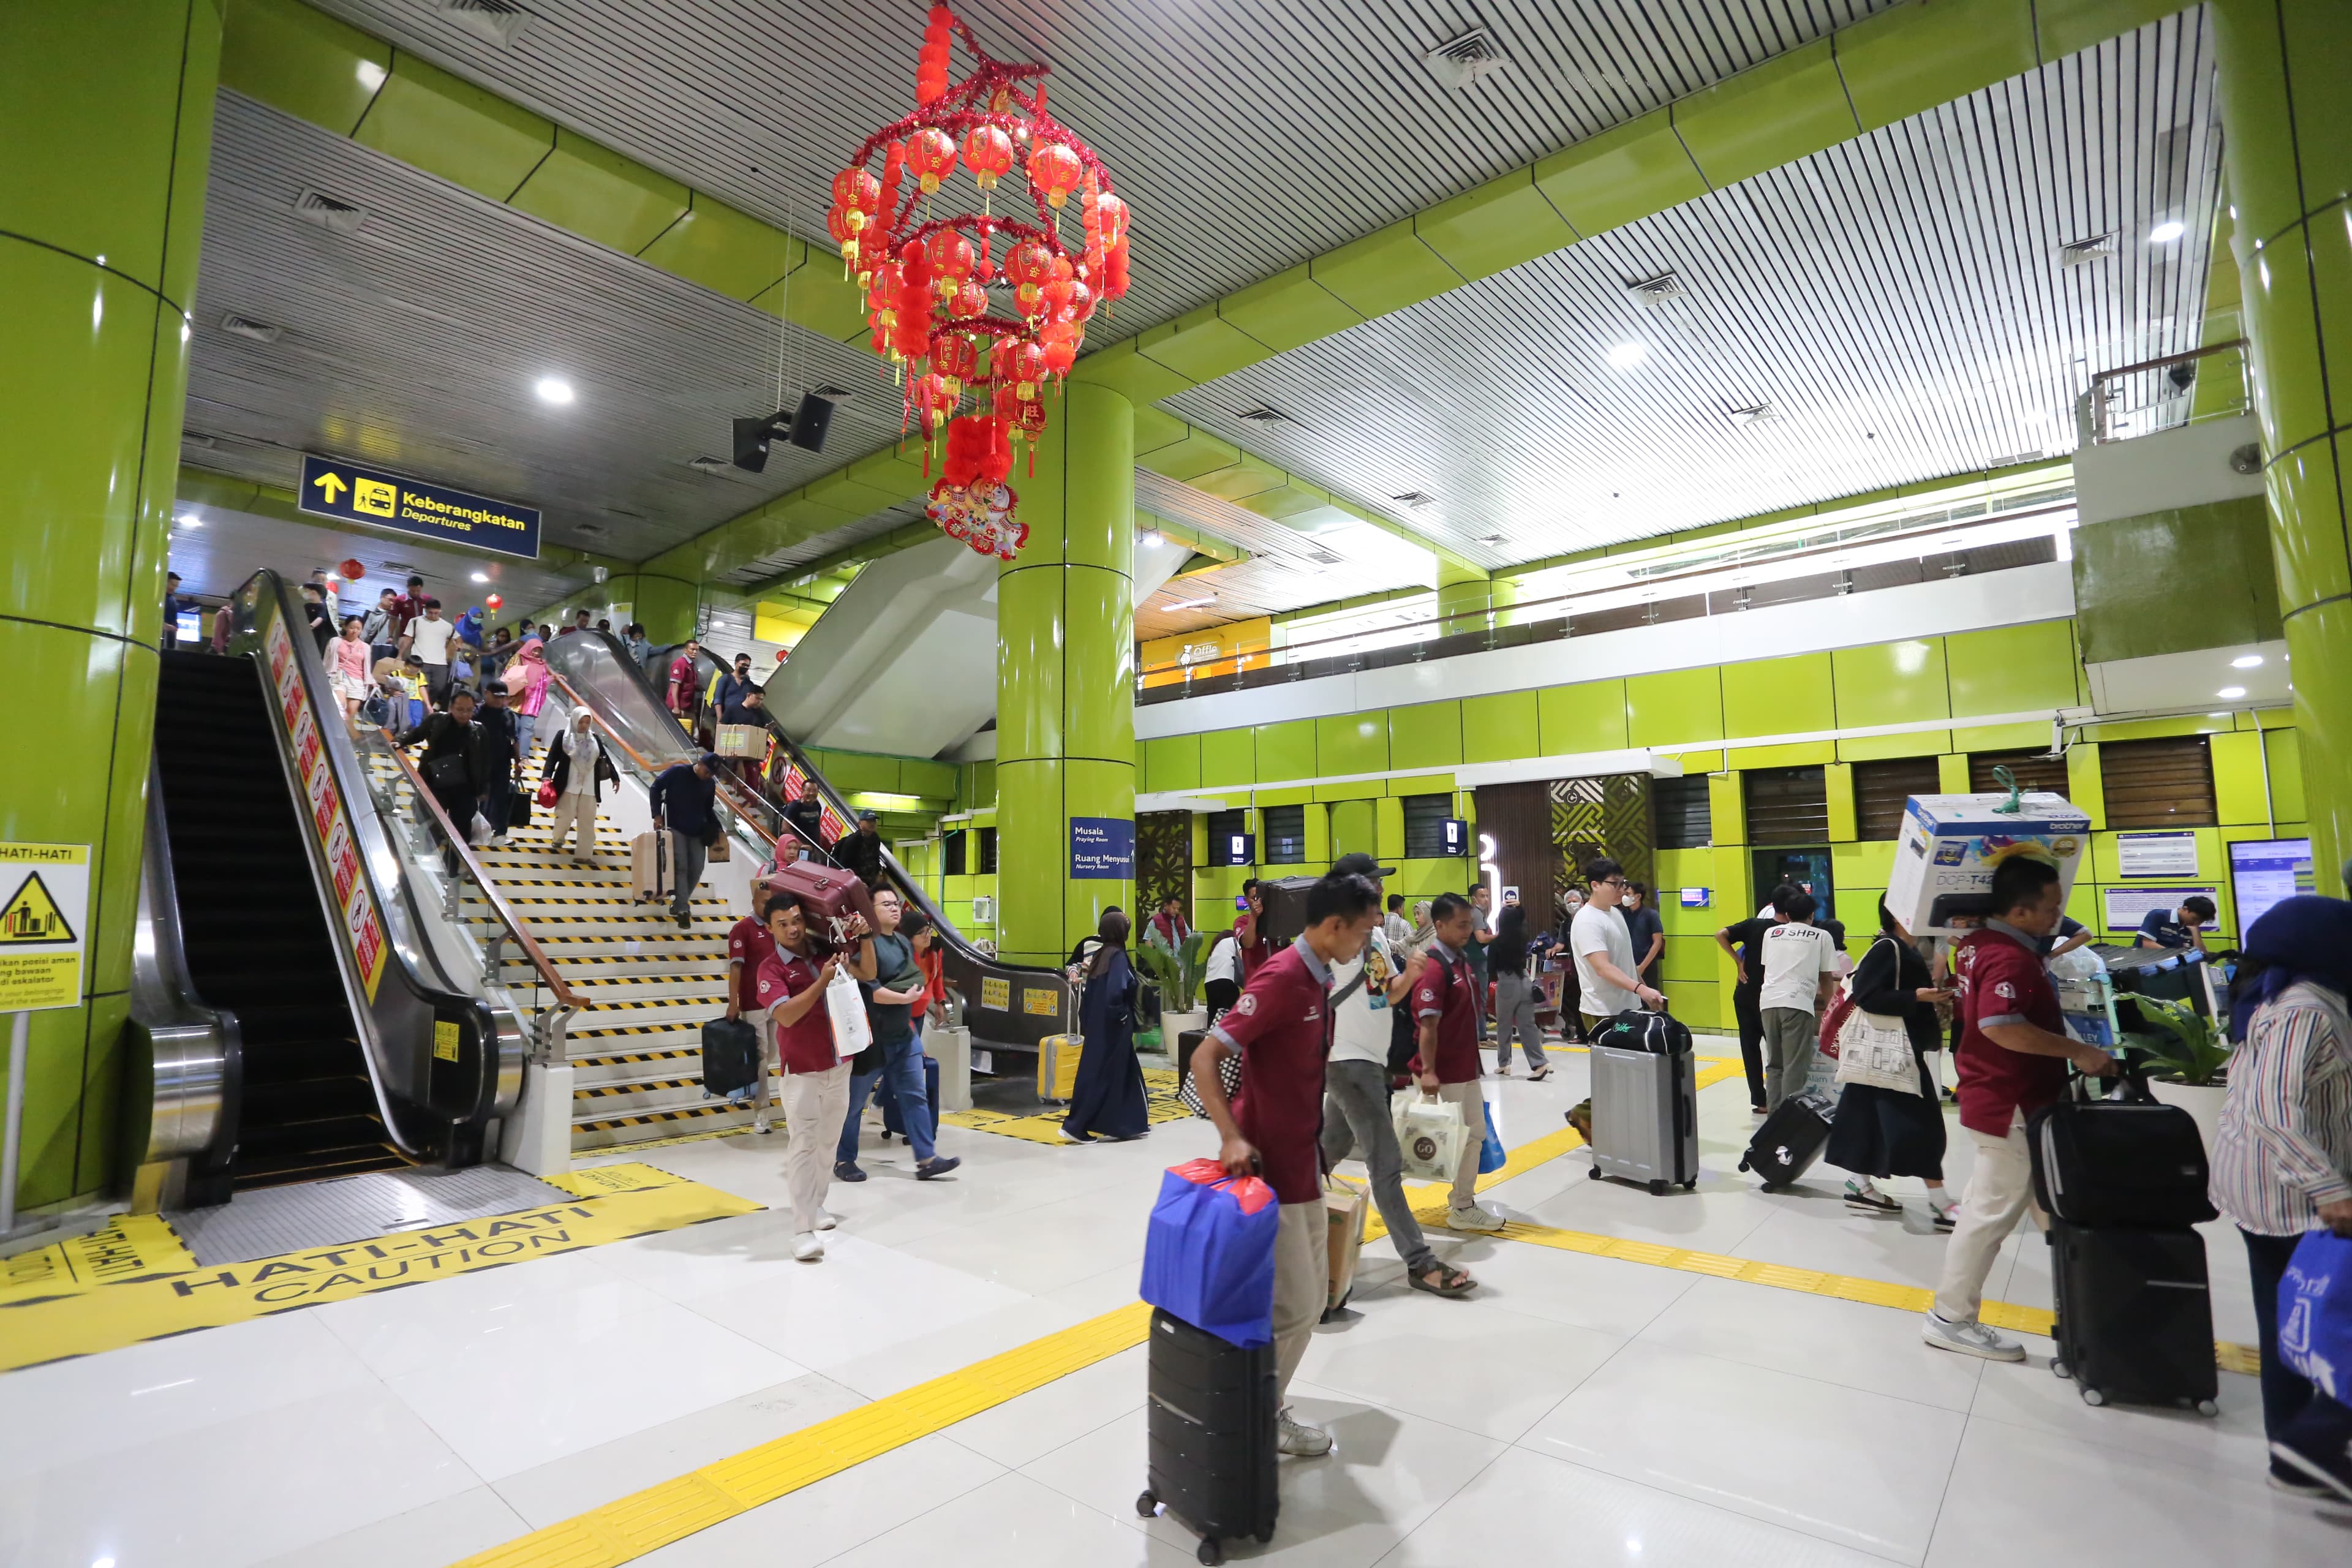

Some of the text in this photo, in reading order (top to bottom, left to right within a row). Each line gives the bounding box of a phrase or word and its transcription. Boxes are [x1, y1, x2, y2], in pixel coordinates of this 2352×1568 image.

[403, 491, 525, 531] Keberangkatan
[401, 507, 472, 532] Departures
[1075, 827, 1104, 835] Musala
[0, 848, 72, 860] HATI-HATI
[1075, 854, 1130, 865] Ruang Menyusui
[1788, 929, 1820, 940] SHPI
[22, 957, 49, 967] posisi
[1807, 1074, 1828, 1084] Alam
[1417, 1144, 1433, 1154] GO
[78, 1221, 146, 1278] ATI-HATI
[172, 1207, 594, 1297] HATI-HATI
[254, 1229, 571, 1302] CAUTION
